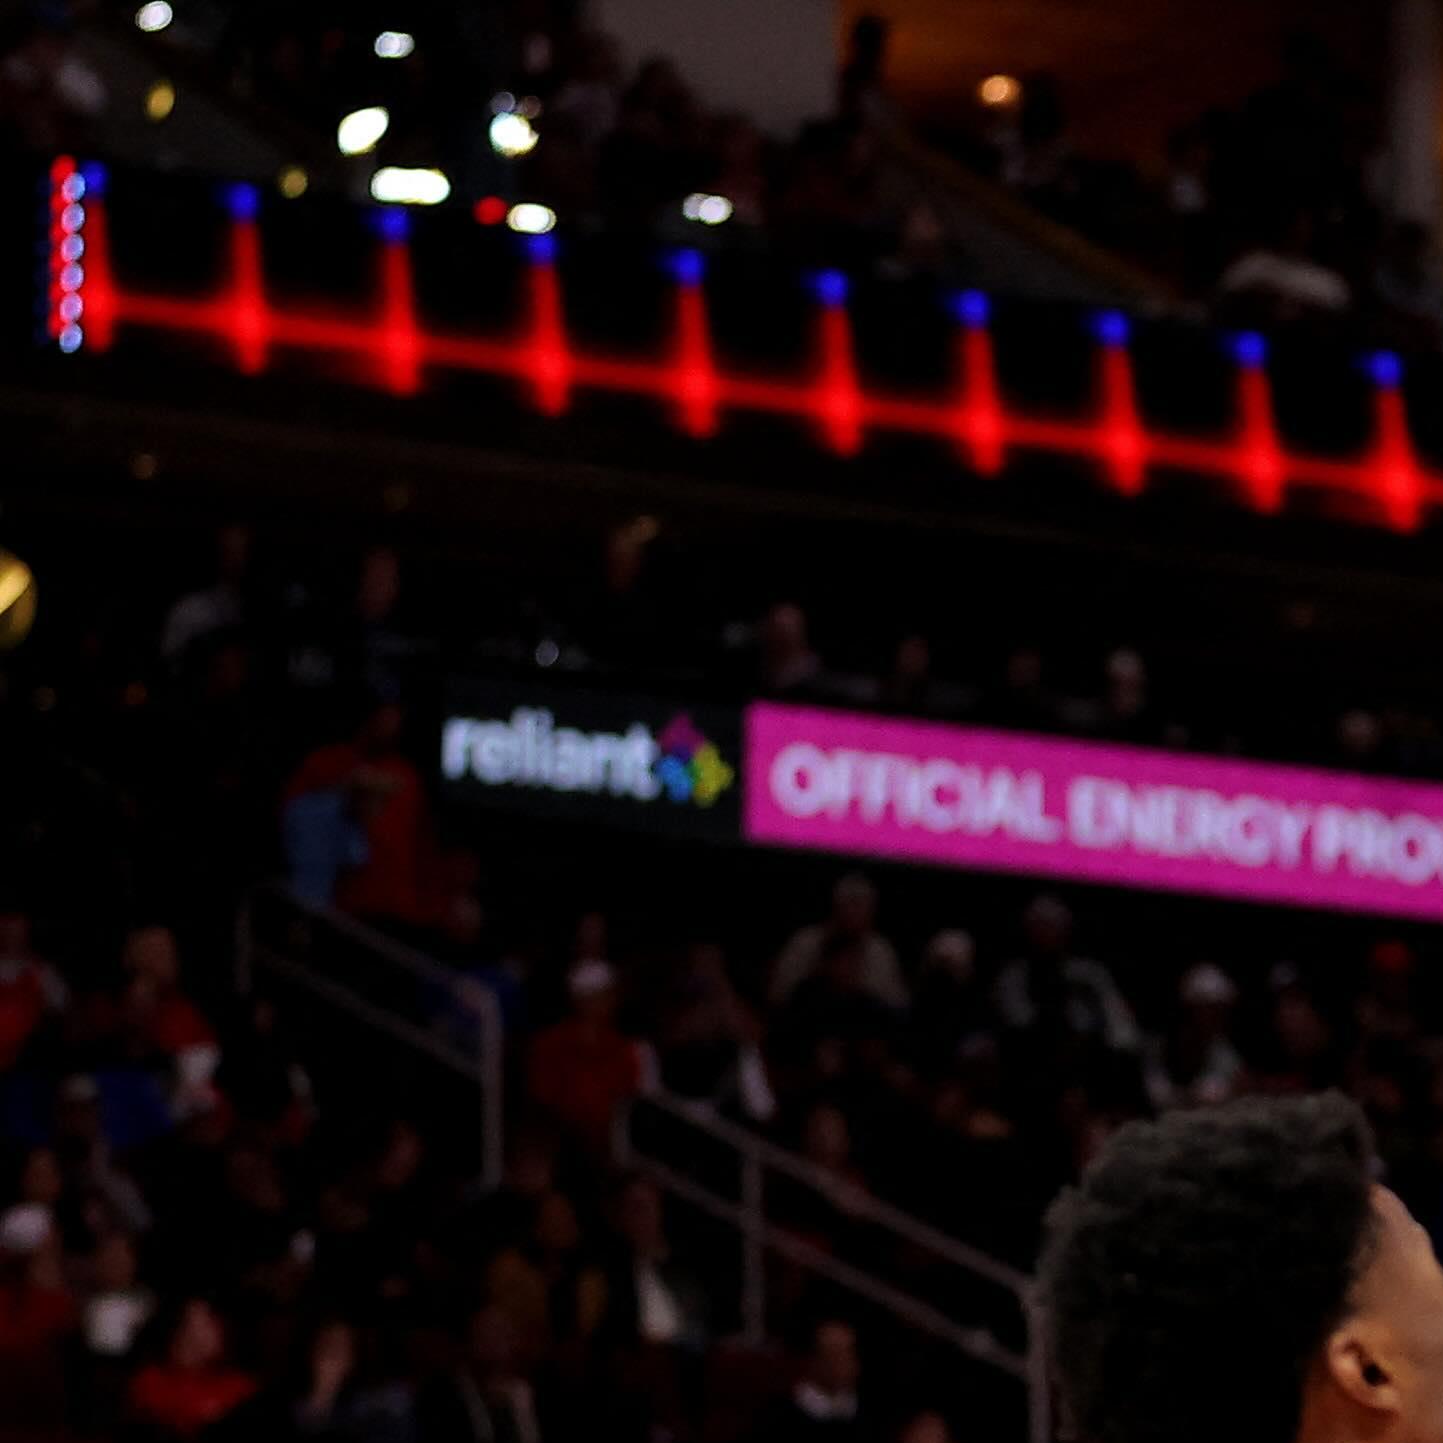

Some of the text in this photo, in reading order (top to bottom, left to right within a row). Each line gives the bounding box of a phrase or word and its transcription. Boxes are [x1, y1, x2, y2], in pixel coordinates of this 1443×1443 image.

[441, 706, 661, 800] reliant
[768, 743, 1062, 842] OFFICIAL
[1067, 775, 1306, 869] ENERGY
